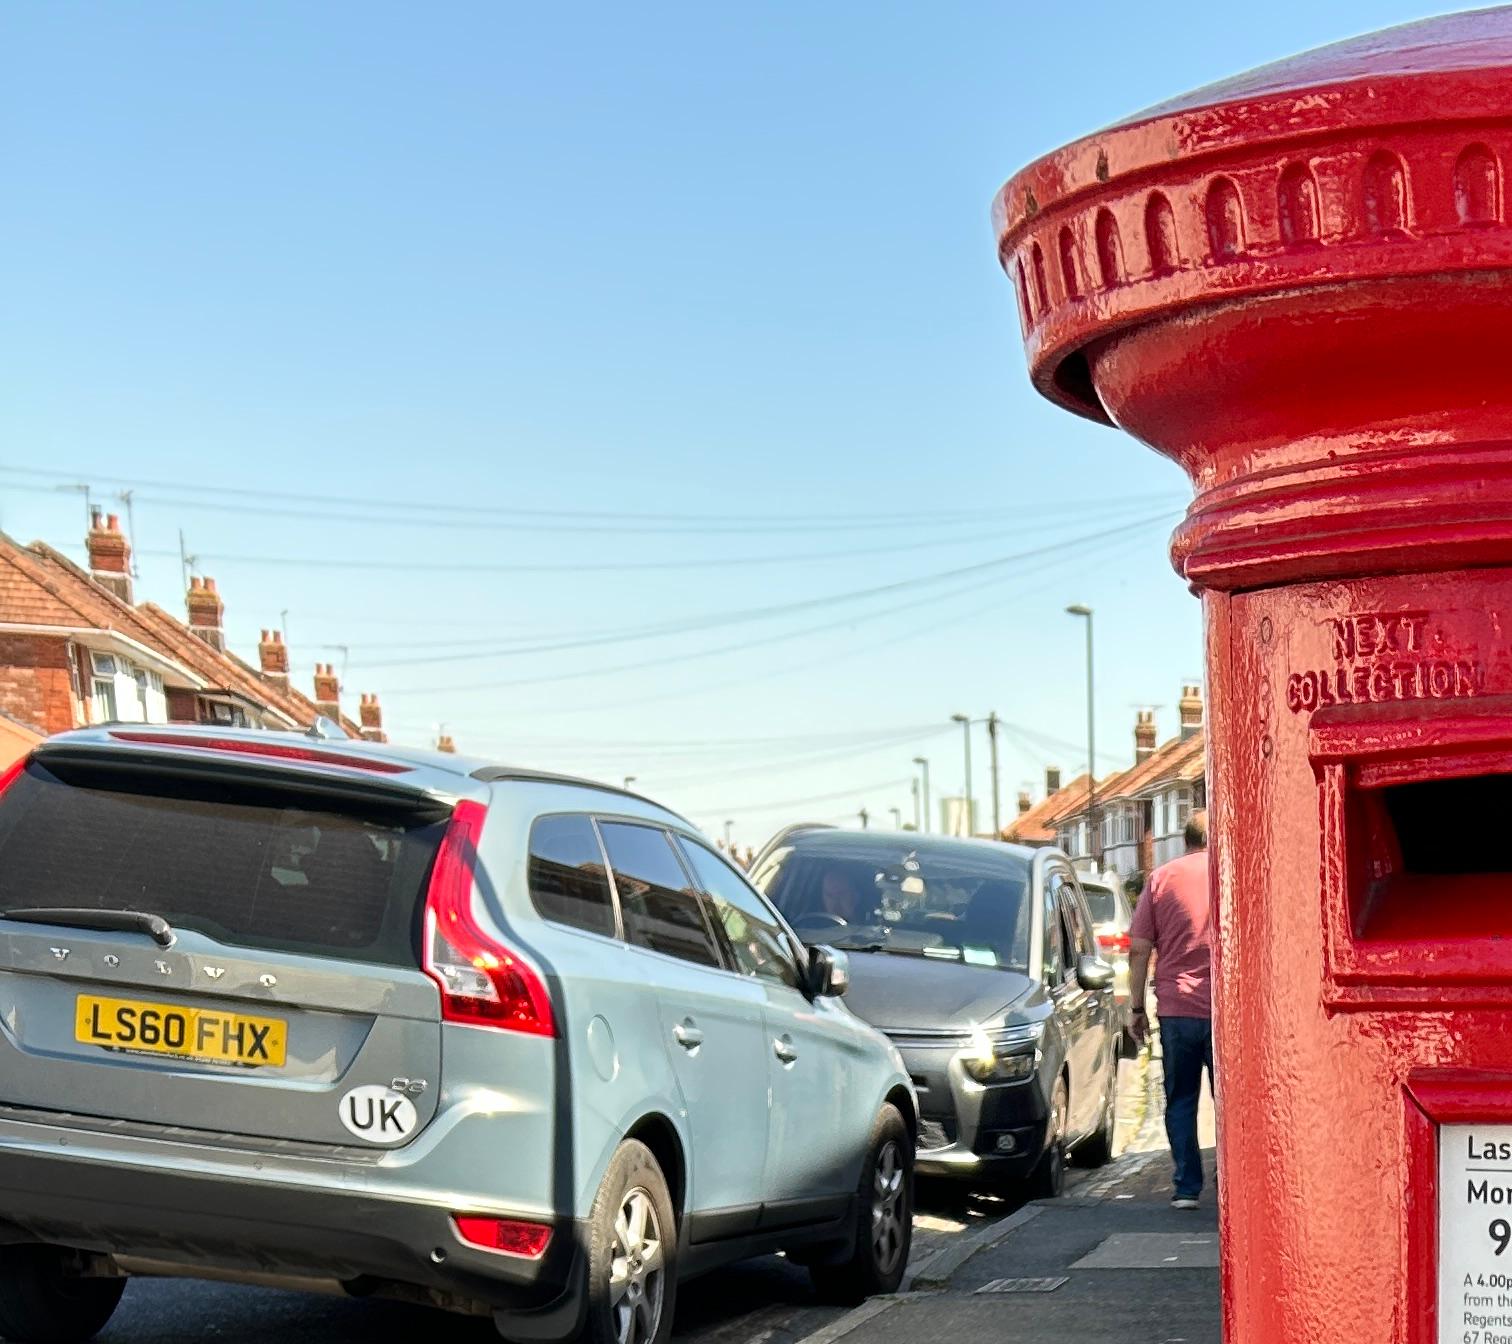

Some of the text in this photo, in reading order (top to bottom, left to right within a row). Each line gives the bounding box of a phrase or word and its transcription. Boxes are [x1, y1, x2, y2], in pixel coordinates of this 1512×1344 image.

[1333, 614, 1428, 663] NEXT
[1287, 660, 1486, 714] COLLECTION
[50, 947, 277, 987] VOLVO
[91, 1003, 271, 1059] LS60 FHX
[350, 1096, 405, 1133] UK
[1463, 1273, 1473, 1288] A
[1463, 1293, 1493, 1307] from
[1463, 1331, 1479, 1344] 67
